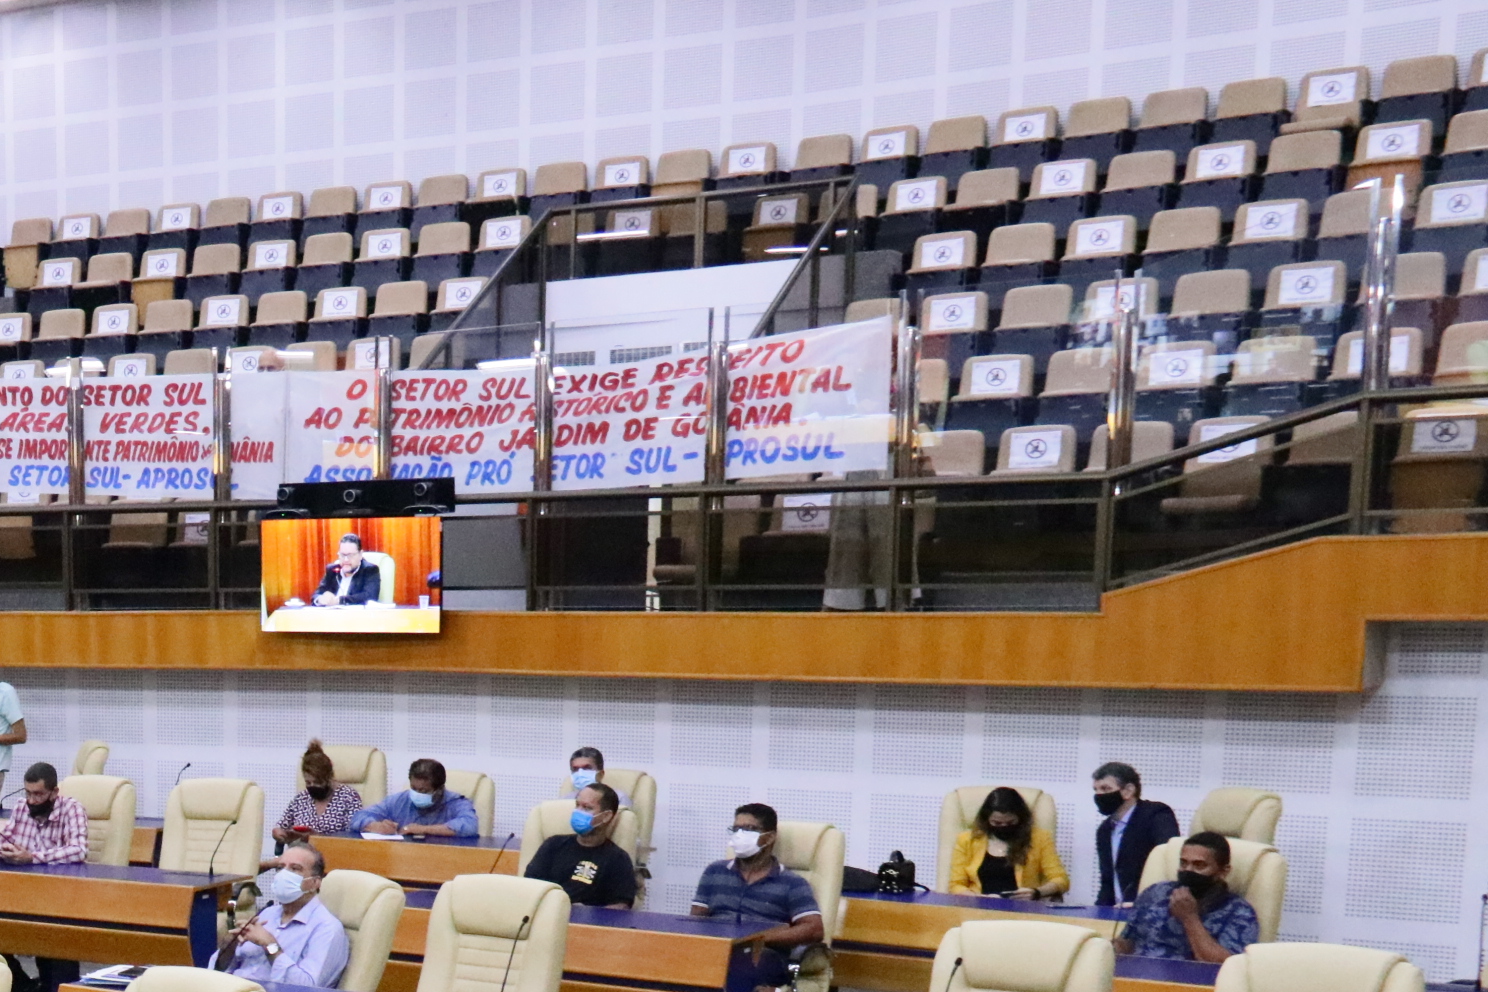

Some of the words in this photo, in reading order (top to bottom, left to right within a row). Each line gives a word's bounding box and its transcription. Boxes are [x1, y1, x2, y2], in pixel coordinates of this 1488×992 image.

[346, 379, 367, 401] O
[391, 378, 468, 402] SETOR
[478, 377, 531, 402] SUL
[553, 367, 638, 395] EXIGE
[648, 339, 805, 385] RESEITO
[41, 385, 69, 407] DO
[83, 384, 152, 407] SETOR
[163, 382, 207, 407] SUL
[303, 407, 343, 429] AO
[656, 384, 675, 410] E
[0, 406, 71, 433] ÁREA
[17, 438, 112, 462] IMPORNTE
[113, 436, 200, 463] PATRIMÔNIO
[335, 435, 373, 458] DO
[391, 431, 484, 457] BAIRRO
[499, 421, 610, 452] JADIM
[623, 416, 659, 442] DE
[465, 451, 516, 487] PRÓ
[530, 452, 606, 483] ETOR
[726, 432, 845, 468] PROSUL
[136, 466, 239, 490] APROS
